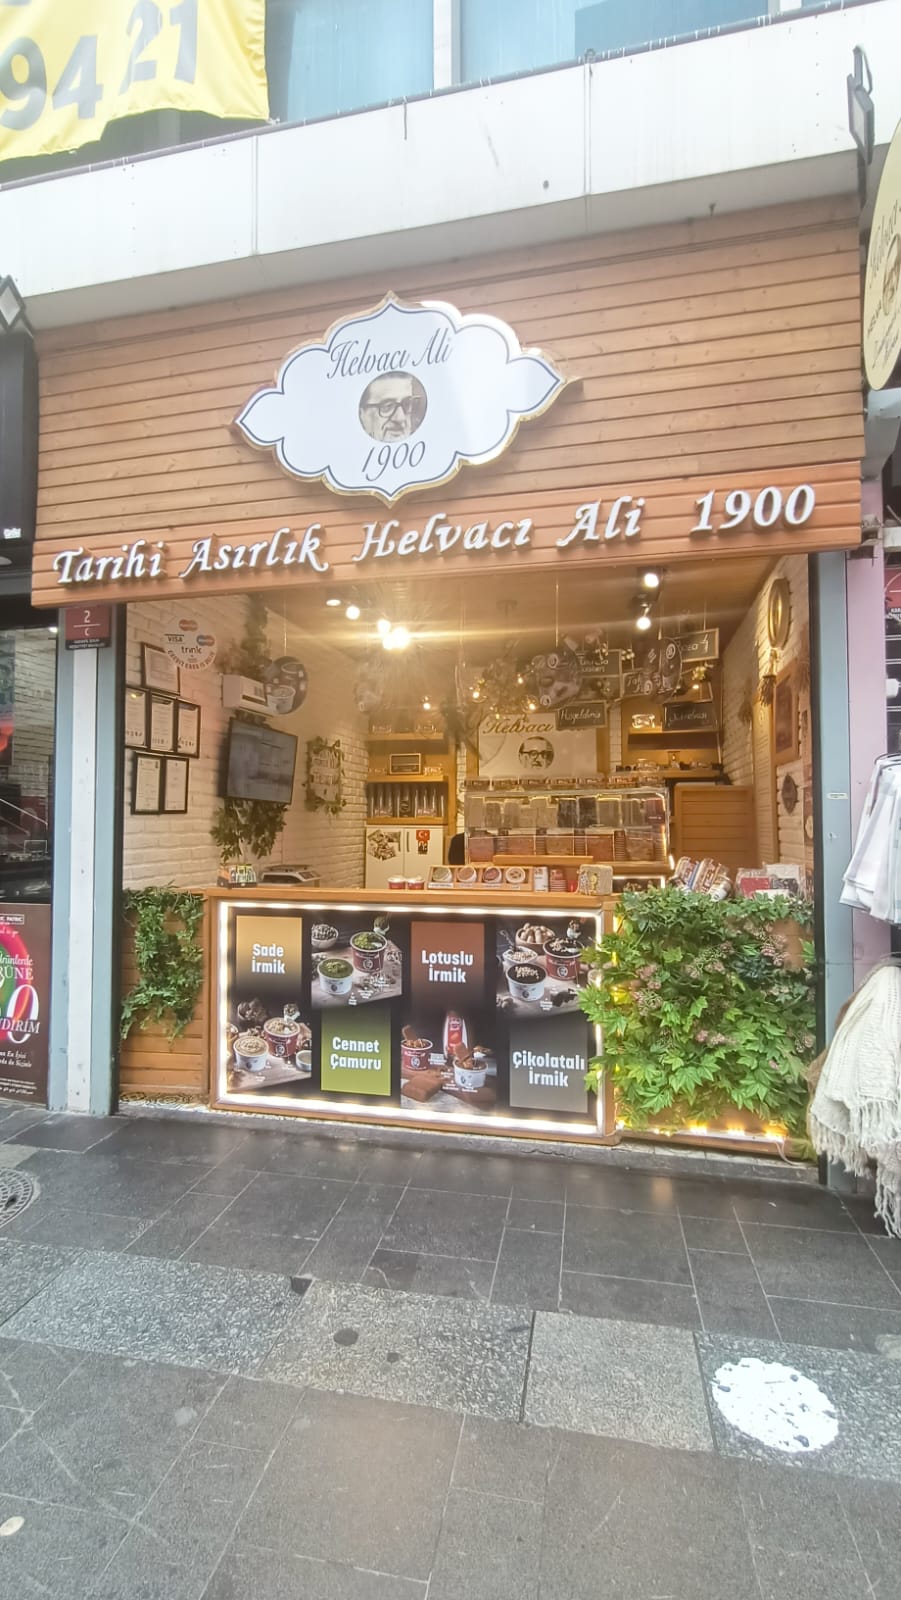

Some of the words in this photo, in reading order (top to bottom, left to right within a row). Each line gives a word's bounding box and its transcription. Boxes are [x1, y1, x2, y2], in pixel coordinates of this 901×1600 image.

[411, 328, 453, 367] Ali
[361, 440, 426, 481] 1900
[53, 540, 165, 585] Tarihi
[178, 523, 329, 579] Asırlık
[352, 512, 533, 563] Helvacı
[556, 495, 645, 547] Ali
[690, 484, 815, 533] 1900
[83, 609, 91, 623] 2
[252, 943, 285, 958] Sade
[421, 949, 474, 966] Lotuslu
[251, 957, 286, 974] İrmik
[428, 965, 467, 983] İrmik
[331, 1036, 381, 1054] Cennet
[329, 1053, 382, 1071] Çamuru
[512, 1050, 586, 1071] Çikolatalı
[527, 1069, 570, 1087] İrmik
